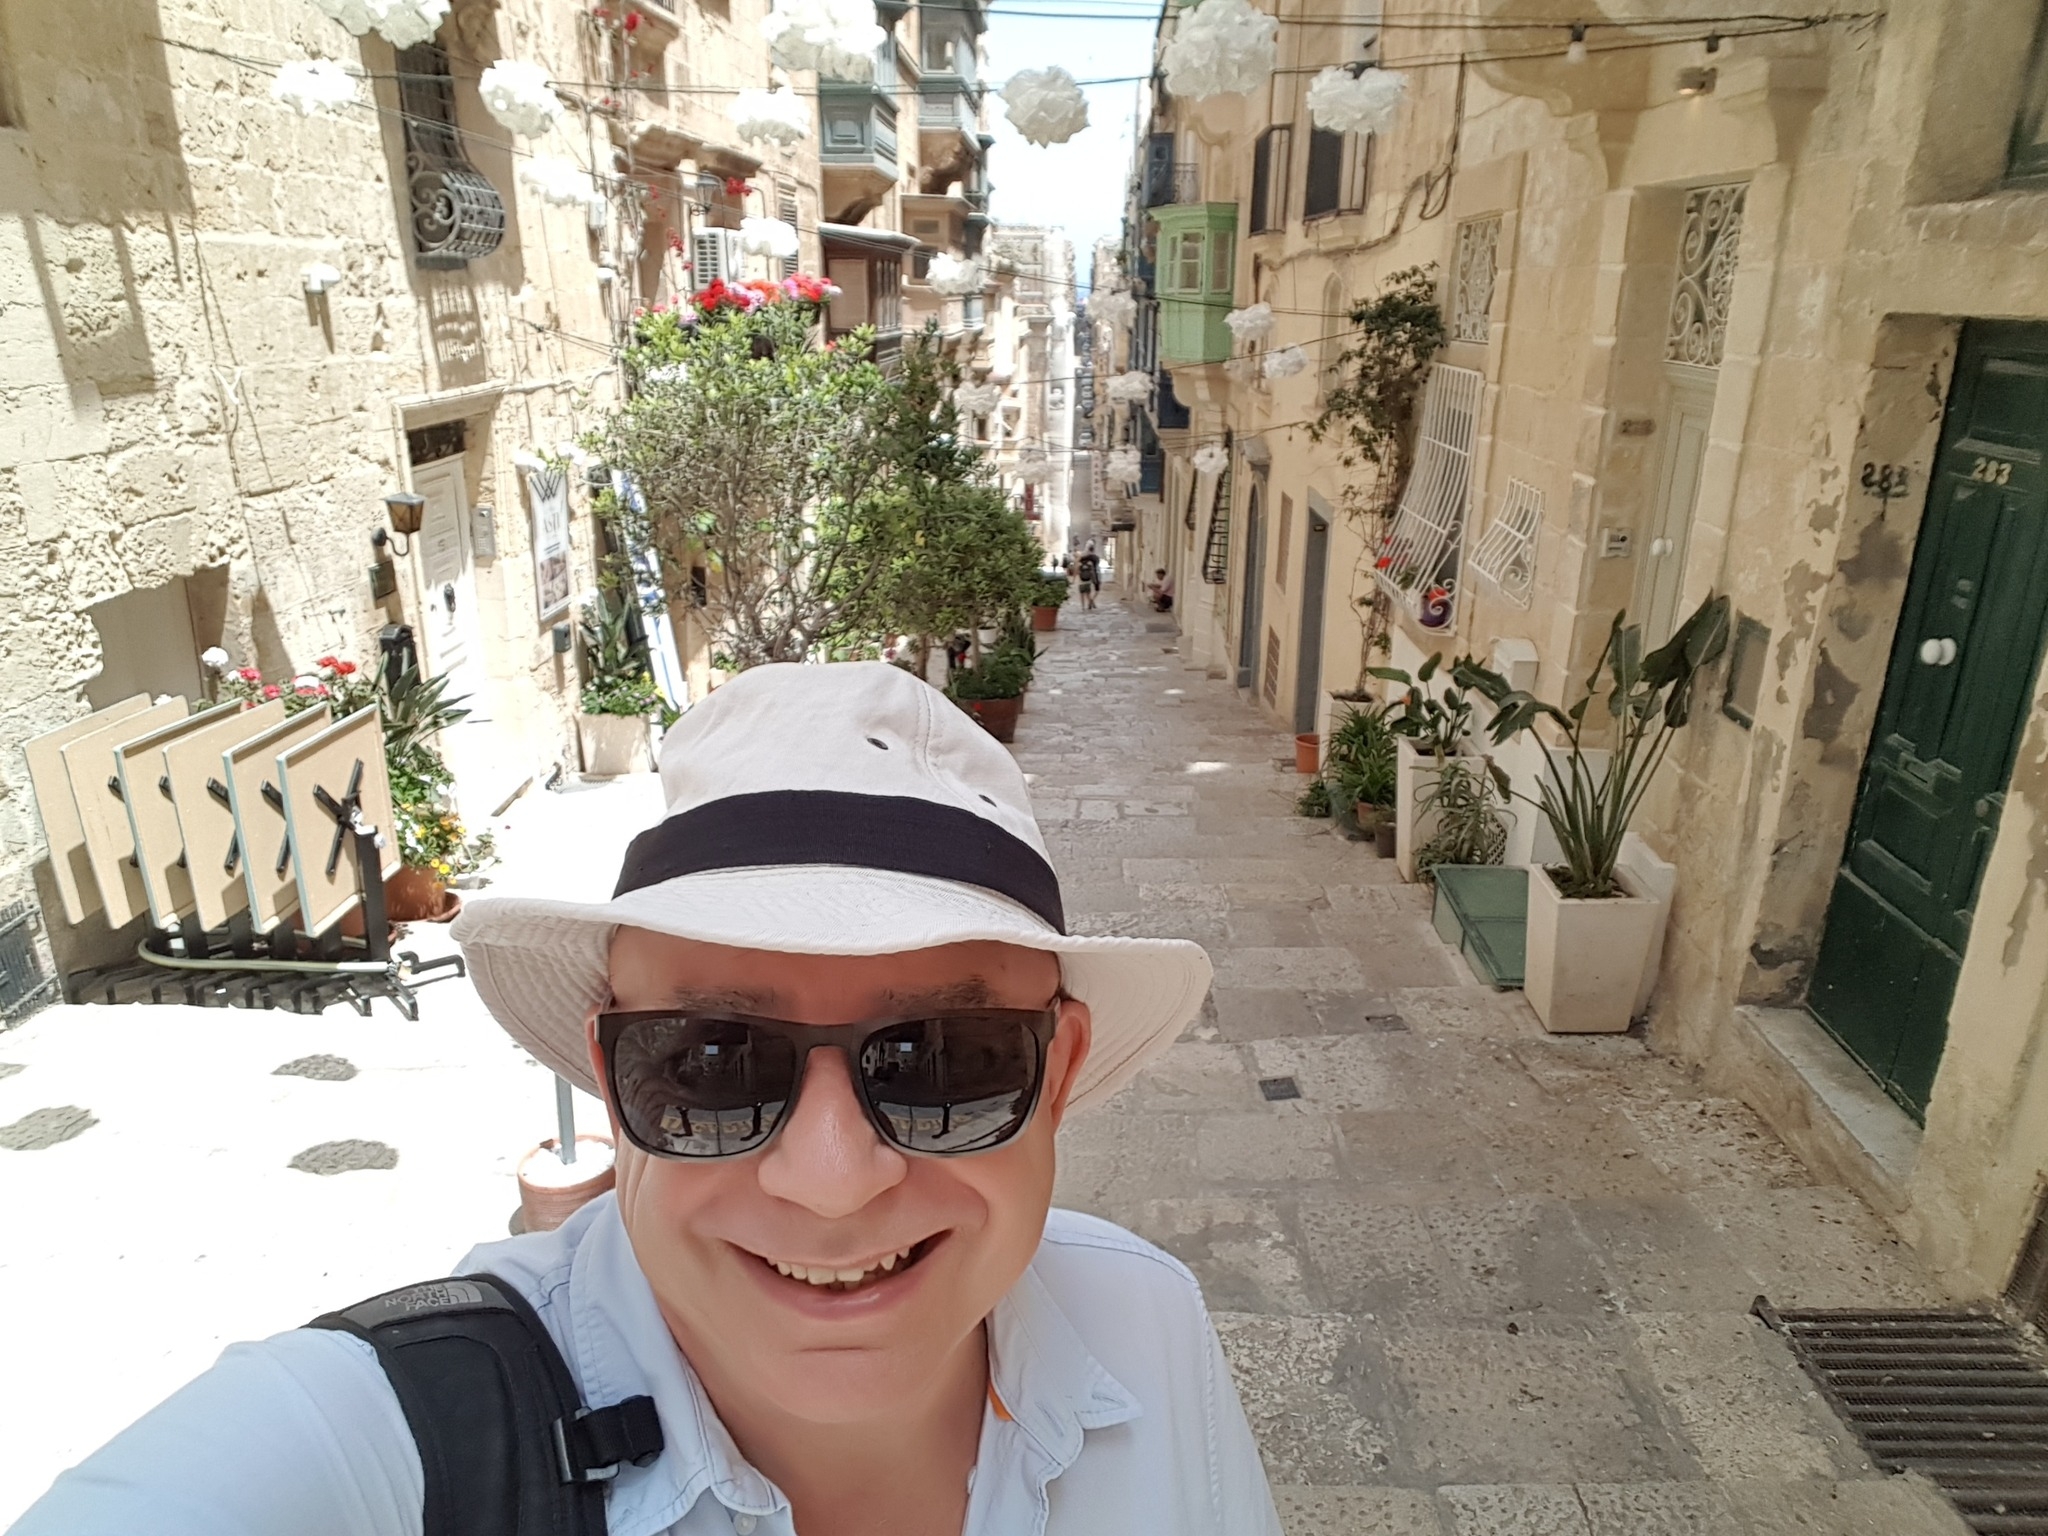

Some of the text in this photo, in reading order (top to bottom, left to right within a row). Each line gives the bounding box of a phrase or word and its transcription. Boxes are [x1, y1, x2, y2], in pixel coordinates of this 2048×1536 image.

[1971, 457, 2012, 485] 283
[384, 1288, 446, 1307] NORTH
[405, 1297, 449, 1310] FACE
